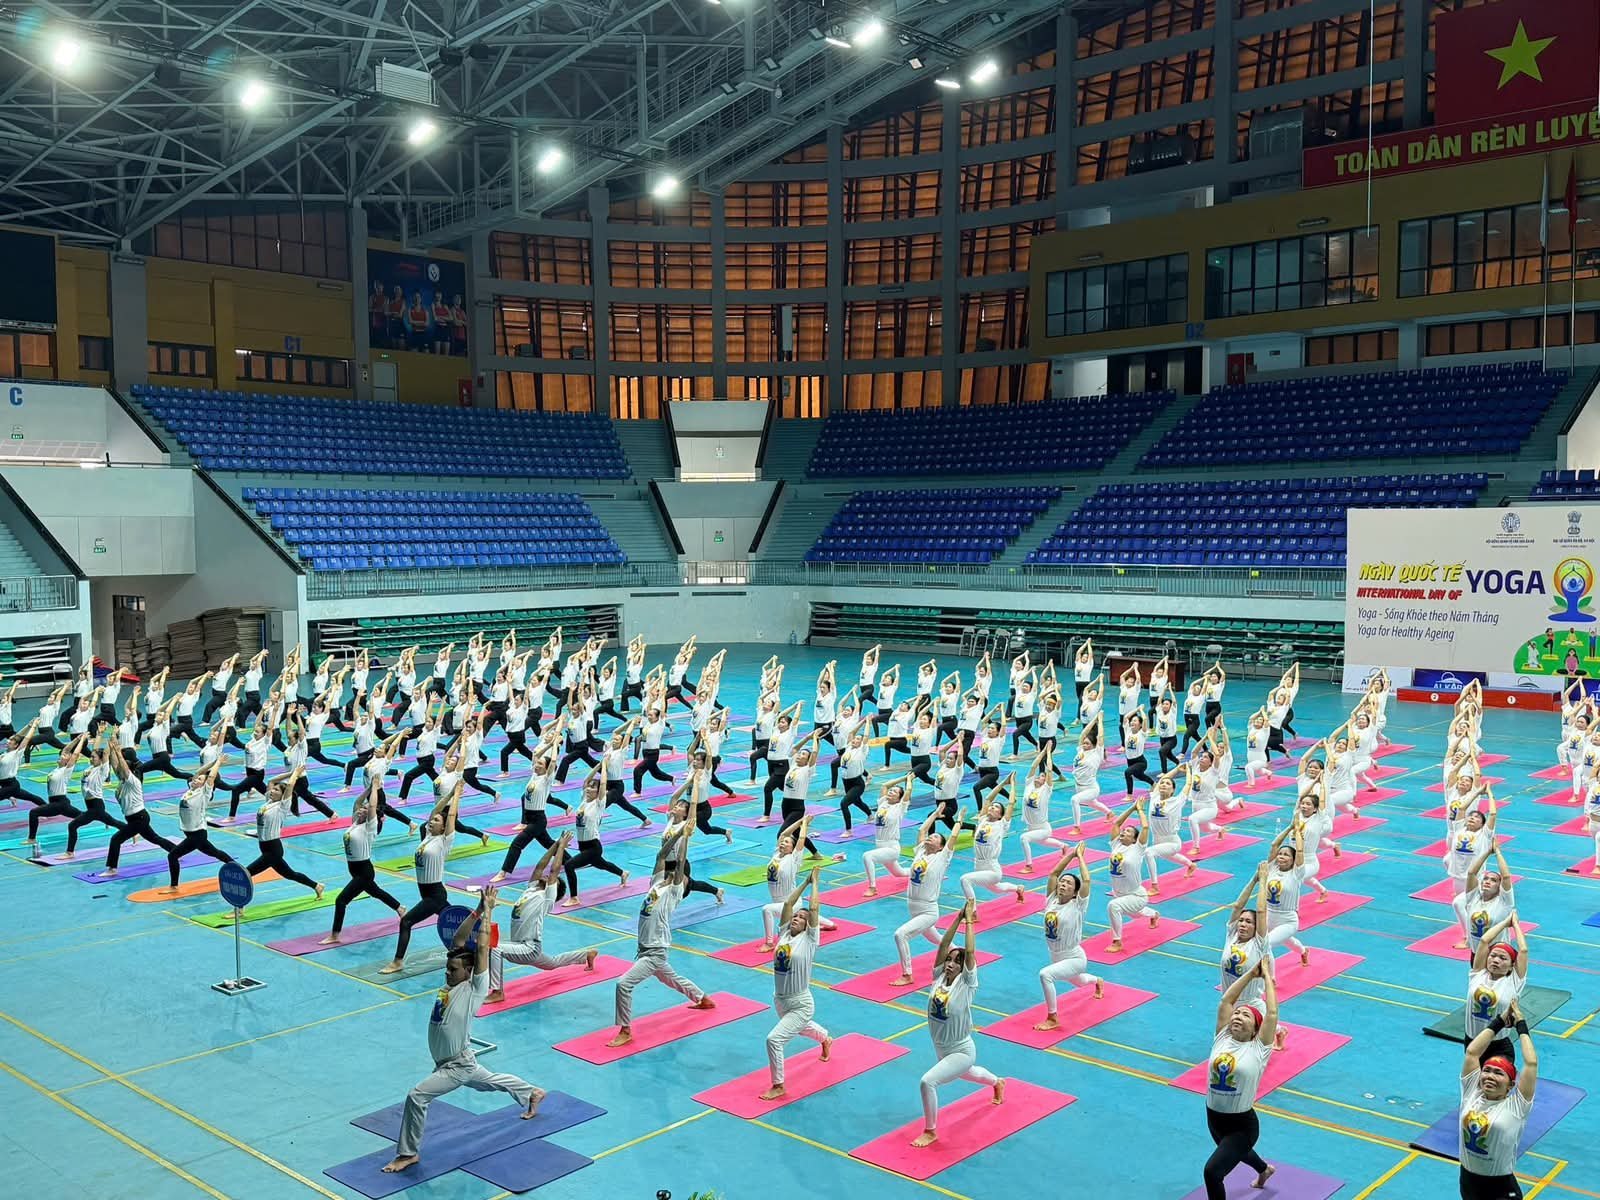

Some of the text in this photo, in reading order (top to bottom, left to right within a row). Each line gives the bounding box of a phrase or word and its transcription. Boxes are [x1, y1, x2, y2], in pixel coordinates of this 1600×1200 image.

[1334, 145, 1399, 176] TOÀN
[1408, 134, 1461, 164] DÂN
[1471, 123, 1525, 153] RÈN
[285, 336, 301, 352] C1
[10, 387, 23, 406] C
[1359, 560, 1467, 583] NGÀY QUỐC TẾ
[1465, 569, 1546, 595] YOGA
[1357, 587, 1463, 600] INTERNATIONAL DAY OF
[1358, 607, 1377, 621] Yoga
[1429, 609, 1448, 621] theo
[1449, 610, 1470, 622] Năm
[1472, 611, 1500, 626] Tháng
[1358, 624, 1455, 643] Yoga for Healthy Ageing
